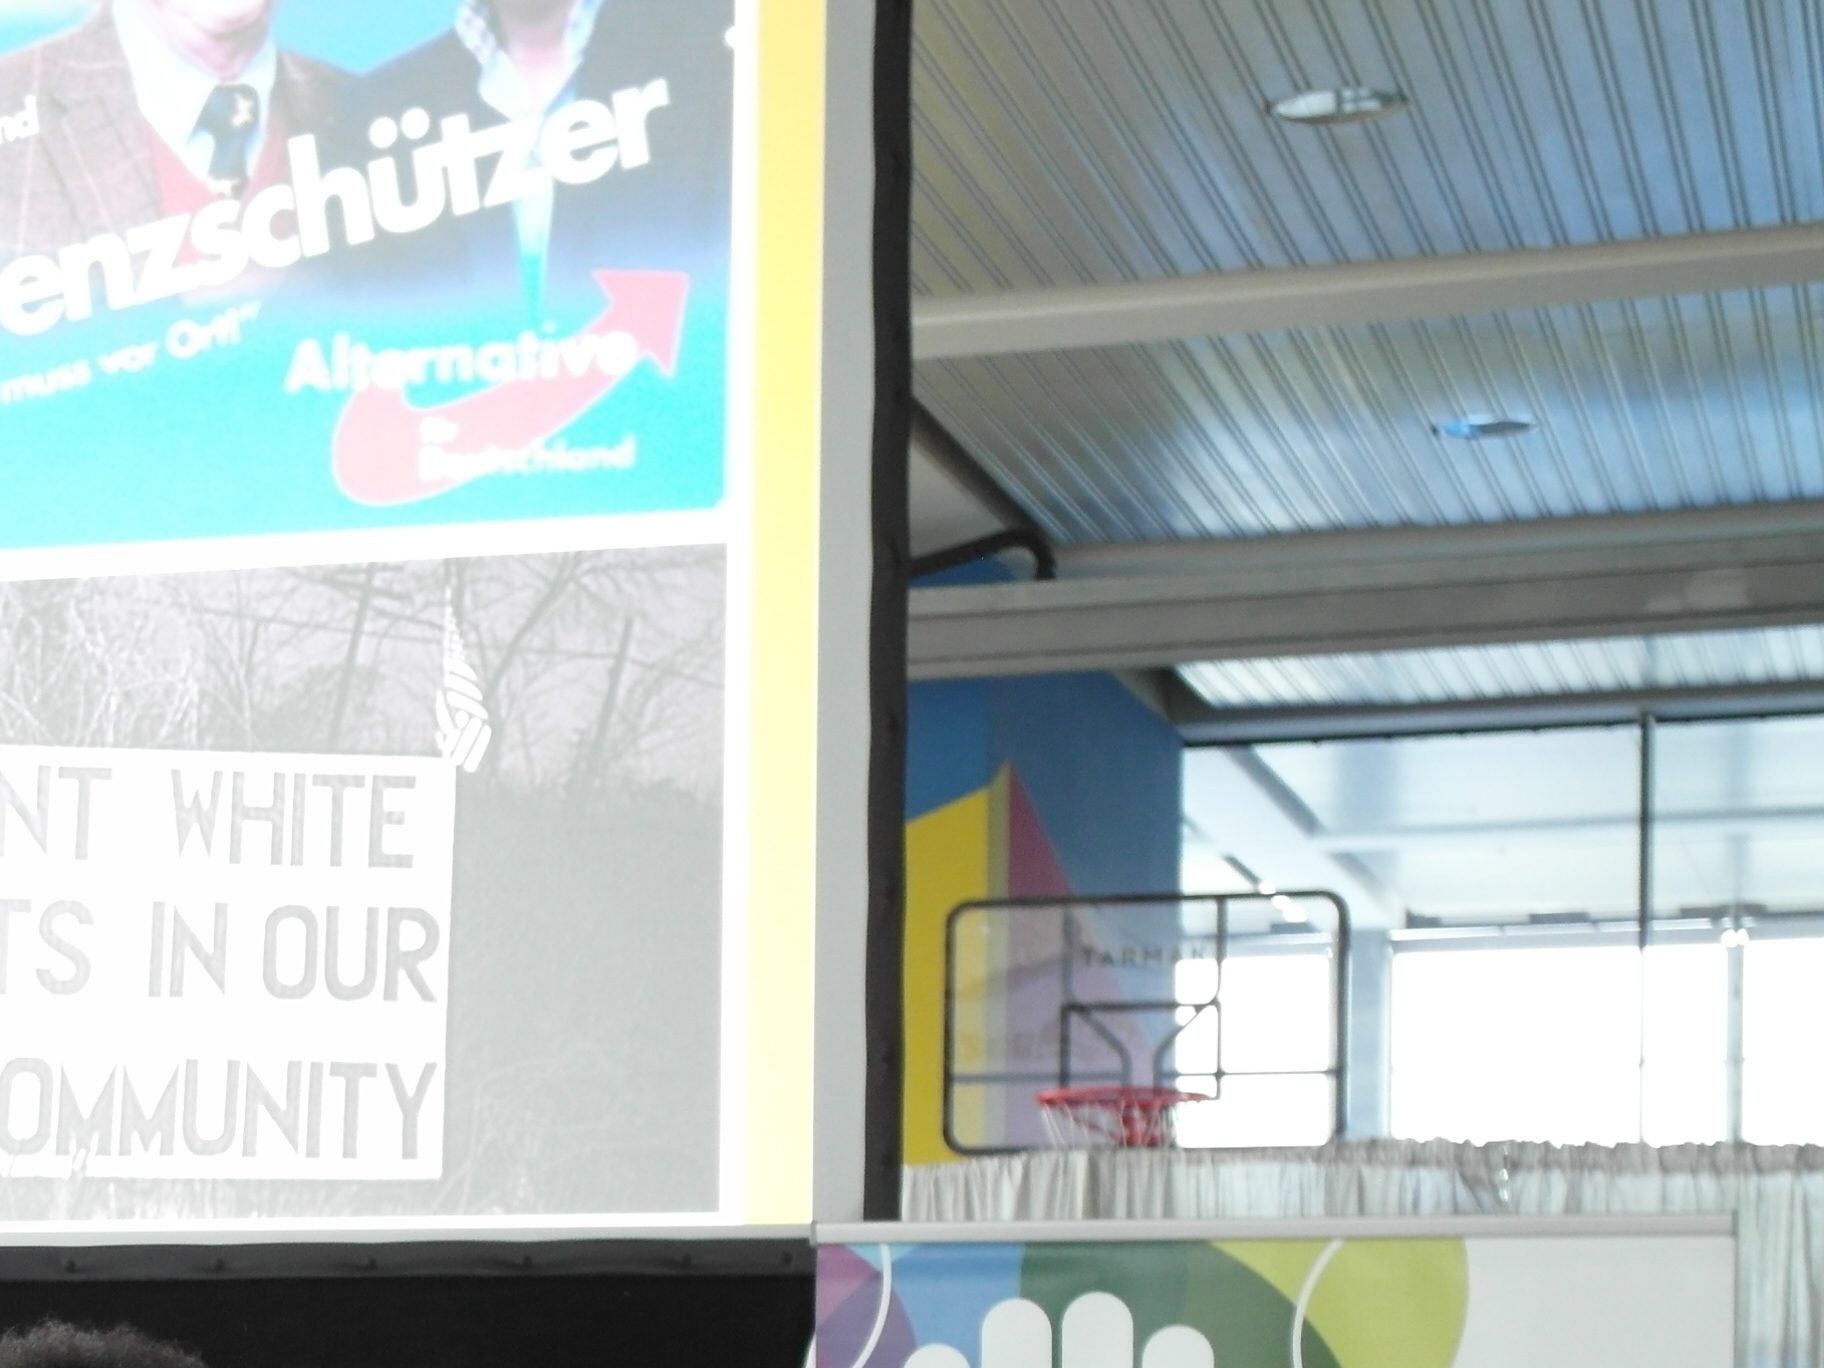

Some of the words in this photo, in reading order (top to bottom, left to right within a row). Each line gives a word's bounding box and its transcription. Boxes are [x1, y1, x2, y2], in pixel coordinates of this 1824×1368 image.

[96, 339, 163, 378] vor
[283, 320, 639, 394] Alternative
[171, 769, 417, 868] WHITE
[148, 900, 228, 998] IN
[262, 904, 440, 1003] OUR
[1081, 943, 1206, 969] TARMAK
